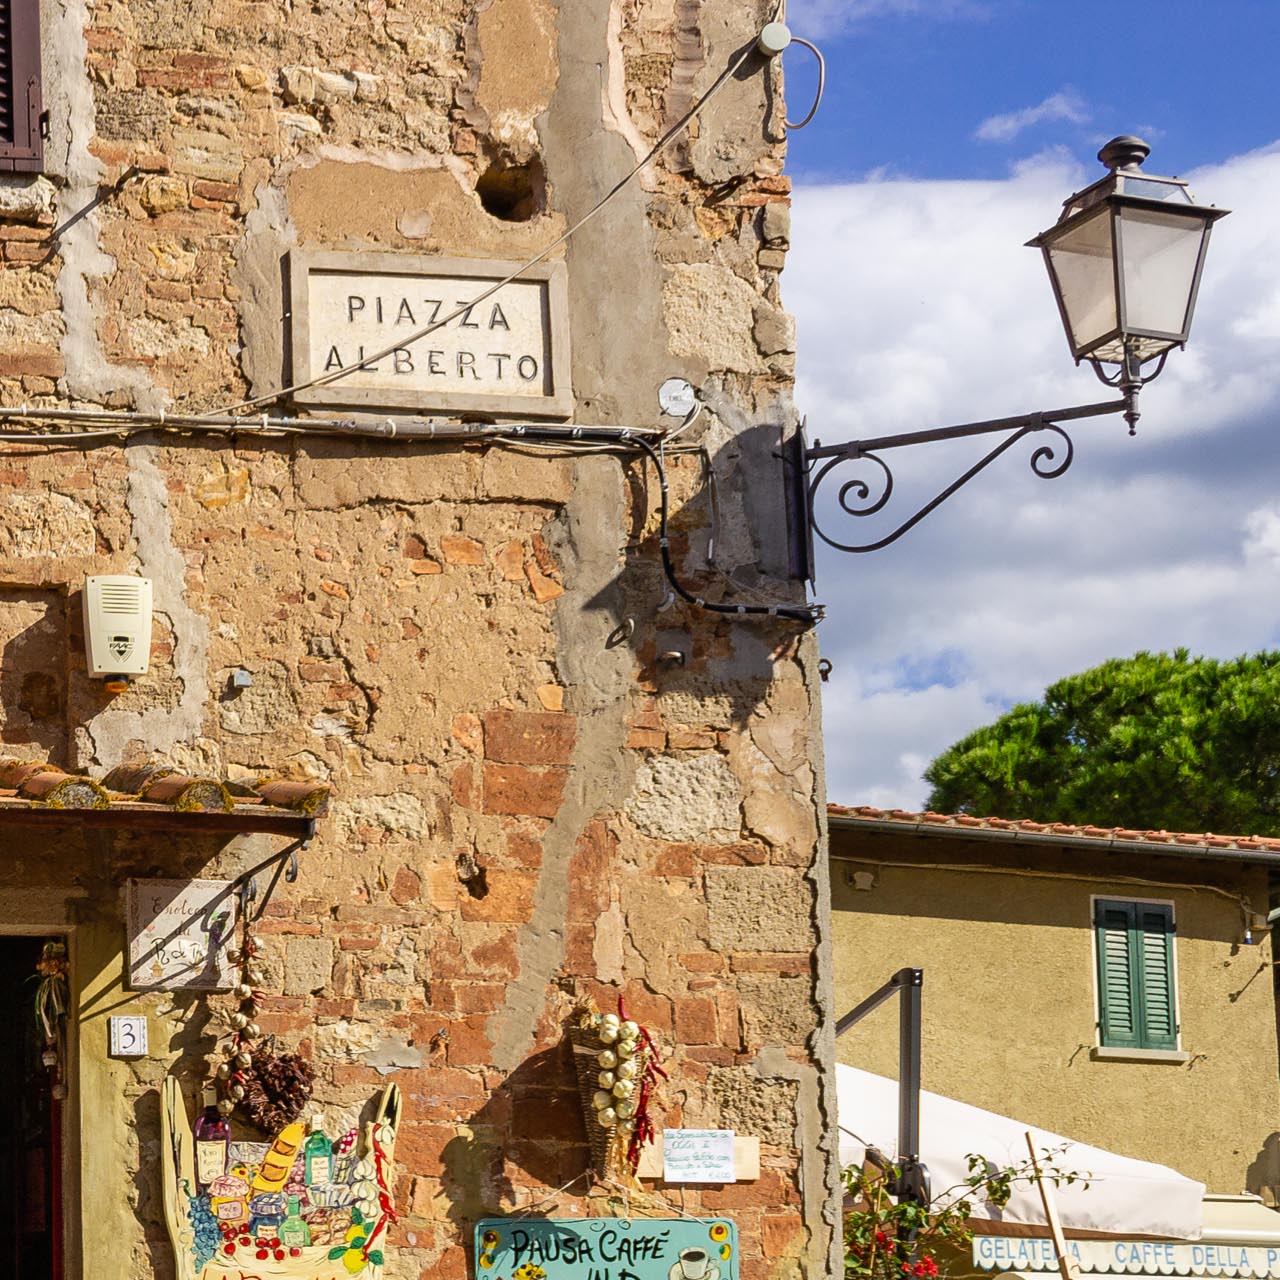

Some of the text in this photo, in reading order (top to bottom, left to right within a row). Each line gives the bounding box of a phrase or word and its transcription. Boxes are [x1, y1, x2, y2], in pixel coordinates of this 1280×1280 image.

[347, 295, 511, 332] PIAZZA
[323, 344, 539, 382] ALBERTO
[121, 1023, 136, 1049] 3
[510, 1229, 594, 1269] PAUSA
[1192, 1246, 1250, 1268] DELLA
